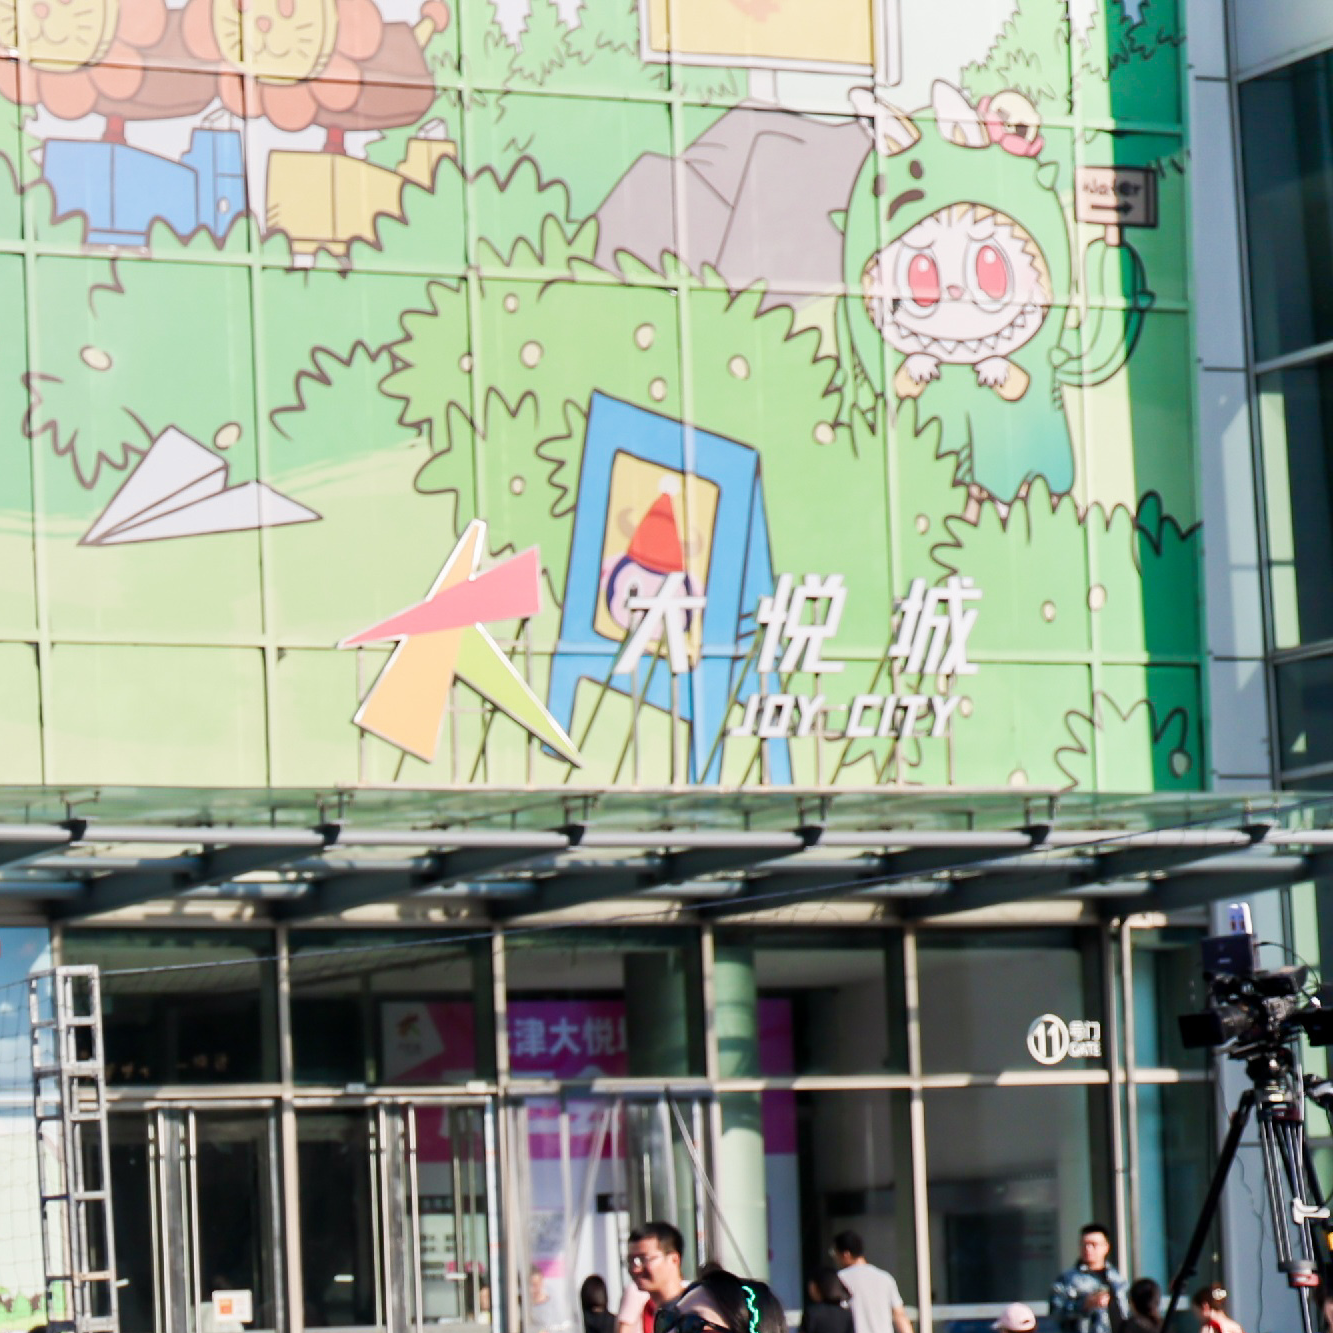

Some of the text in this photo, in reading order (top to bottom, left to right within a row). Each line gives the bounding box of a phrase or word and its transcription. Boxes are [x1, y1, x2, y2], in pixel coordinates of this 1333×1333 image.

[614, 572, 984, 674] 大悦城
[732, 693, 961, 737] JOY CITY
[508, 1014, 626, 1058] 津大悦
[1031, 1019, 1064, 1061] 11
